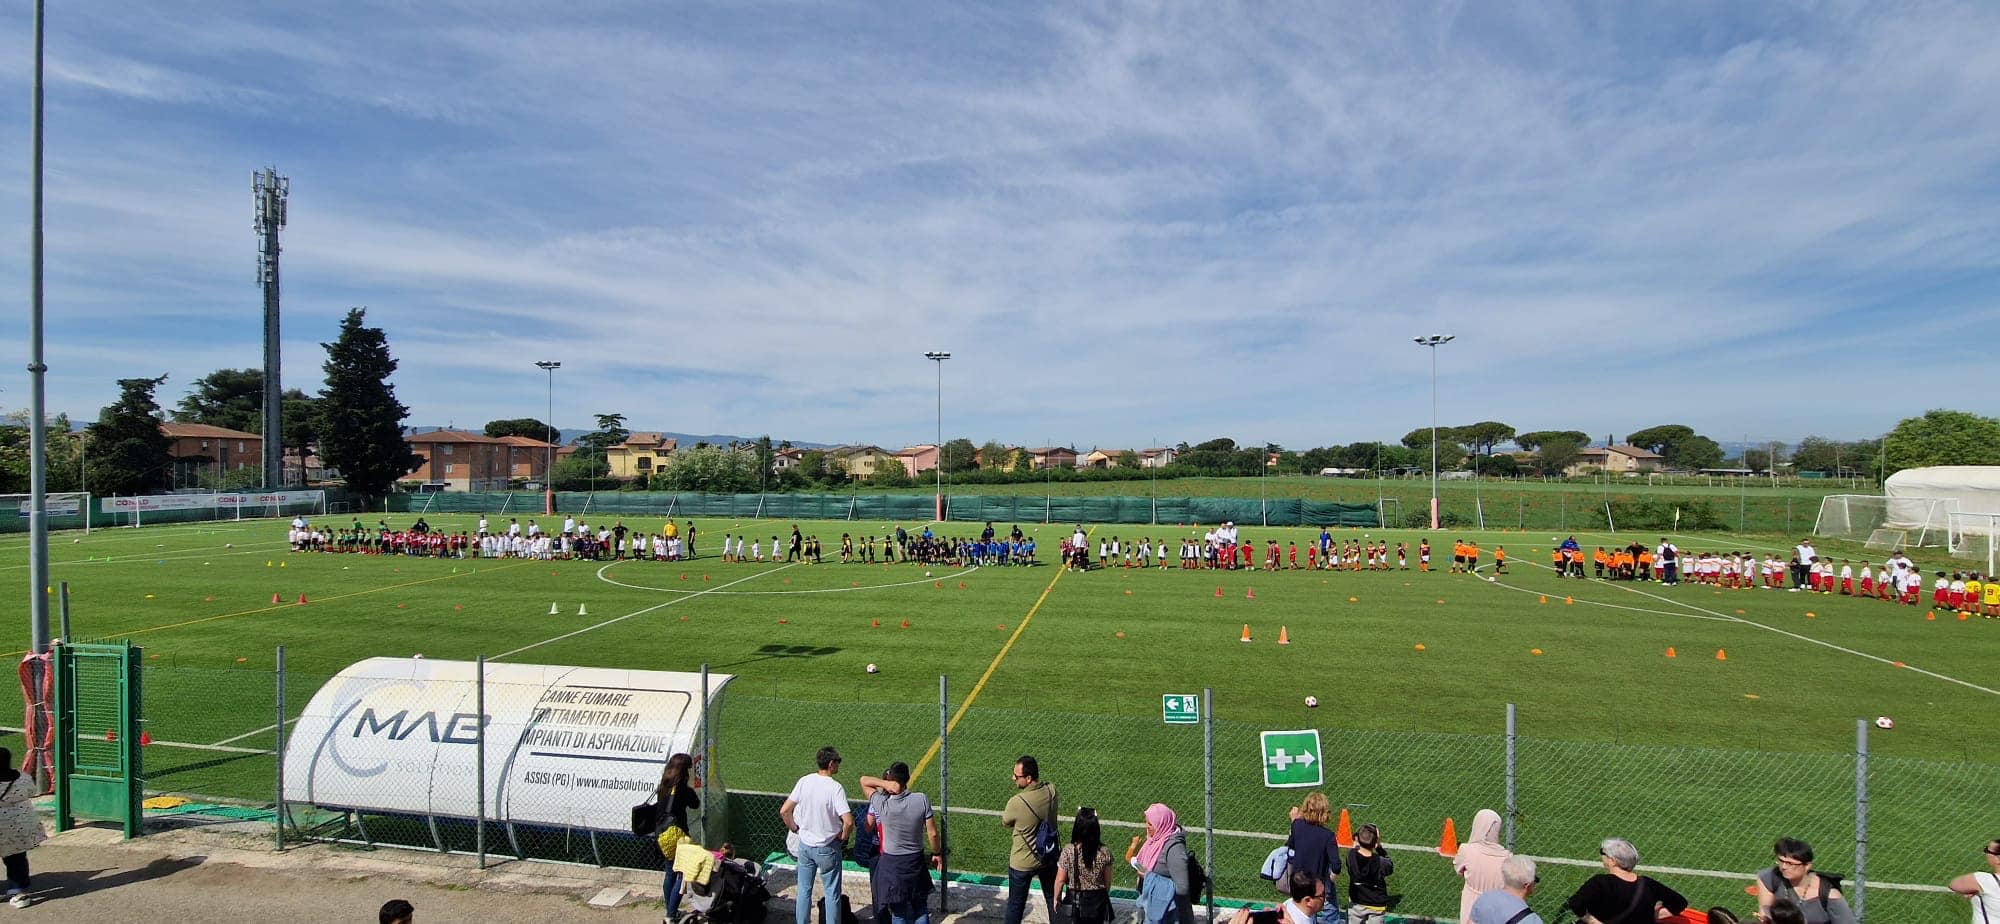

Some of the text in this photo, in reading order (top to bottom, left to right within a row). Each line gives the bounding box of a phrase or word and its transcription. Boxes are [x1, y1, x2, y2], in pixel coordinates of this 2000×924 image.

[540, 690, 633, 707] CANNE FUMARIE
[353, 708, 492, 745] MAB
[532, 707, 639, 728] TRATTAMENTO ARIA
[522, 729, 666, 754] MPIANTI DI ASPIRAZIONE
[524, 771, 551, 785] ASSISI
[551, 771, 570, 788] (PG)
